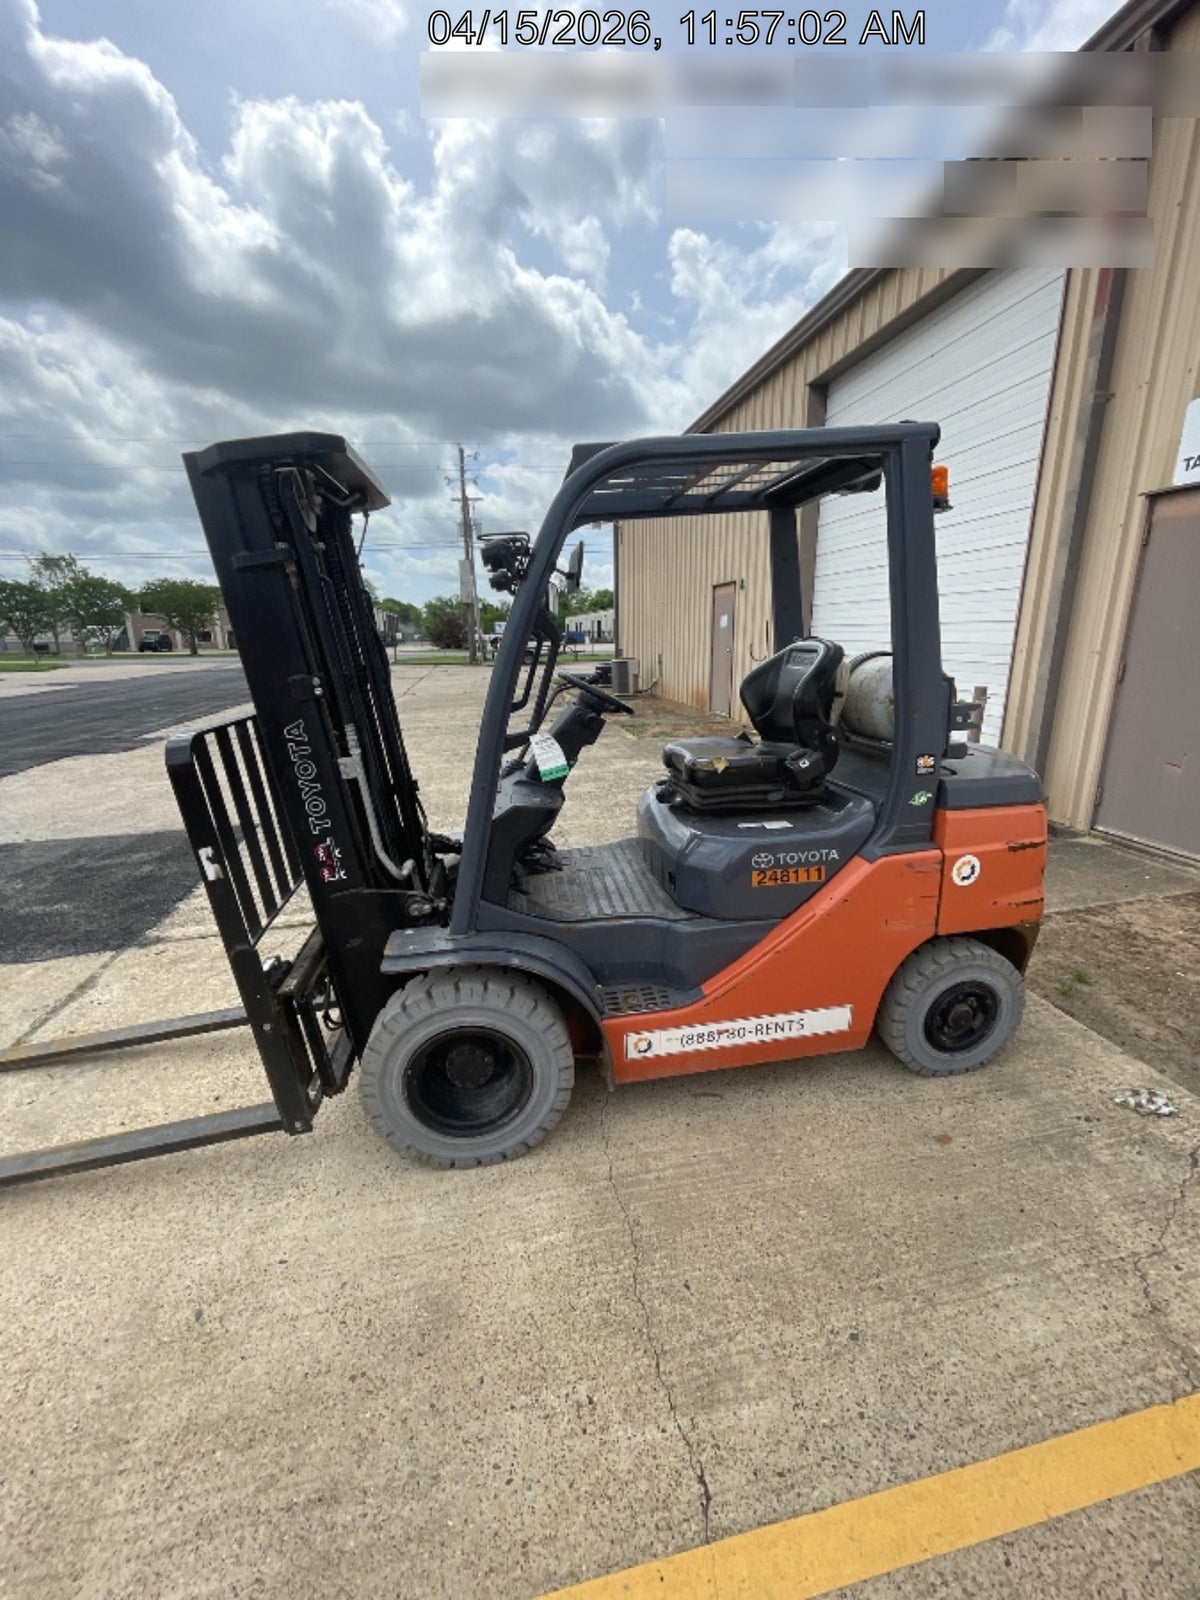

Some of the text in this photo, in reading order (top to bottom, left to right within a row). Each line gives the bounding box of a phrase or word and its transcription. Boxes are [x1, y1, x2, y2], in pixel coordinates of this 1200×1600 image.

[283, 719, 331, 835] TOYOTA
[777, 848, 840, 865] TOYOTA
[756, 866, 823, 886] 248111
